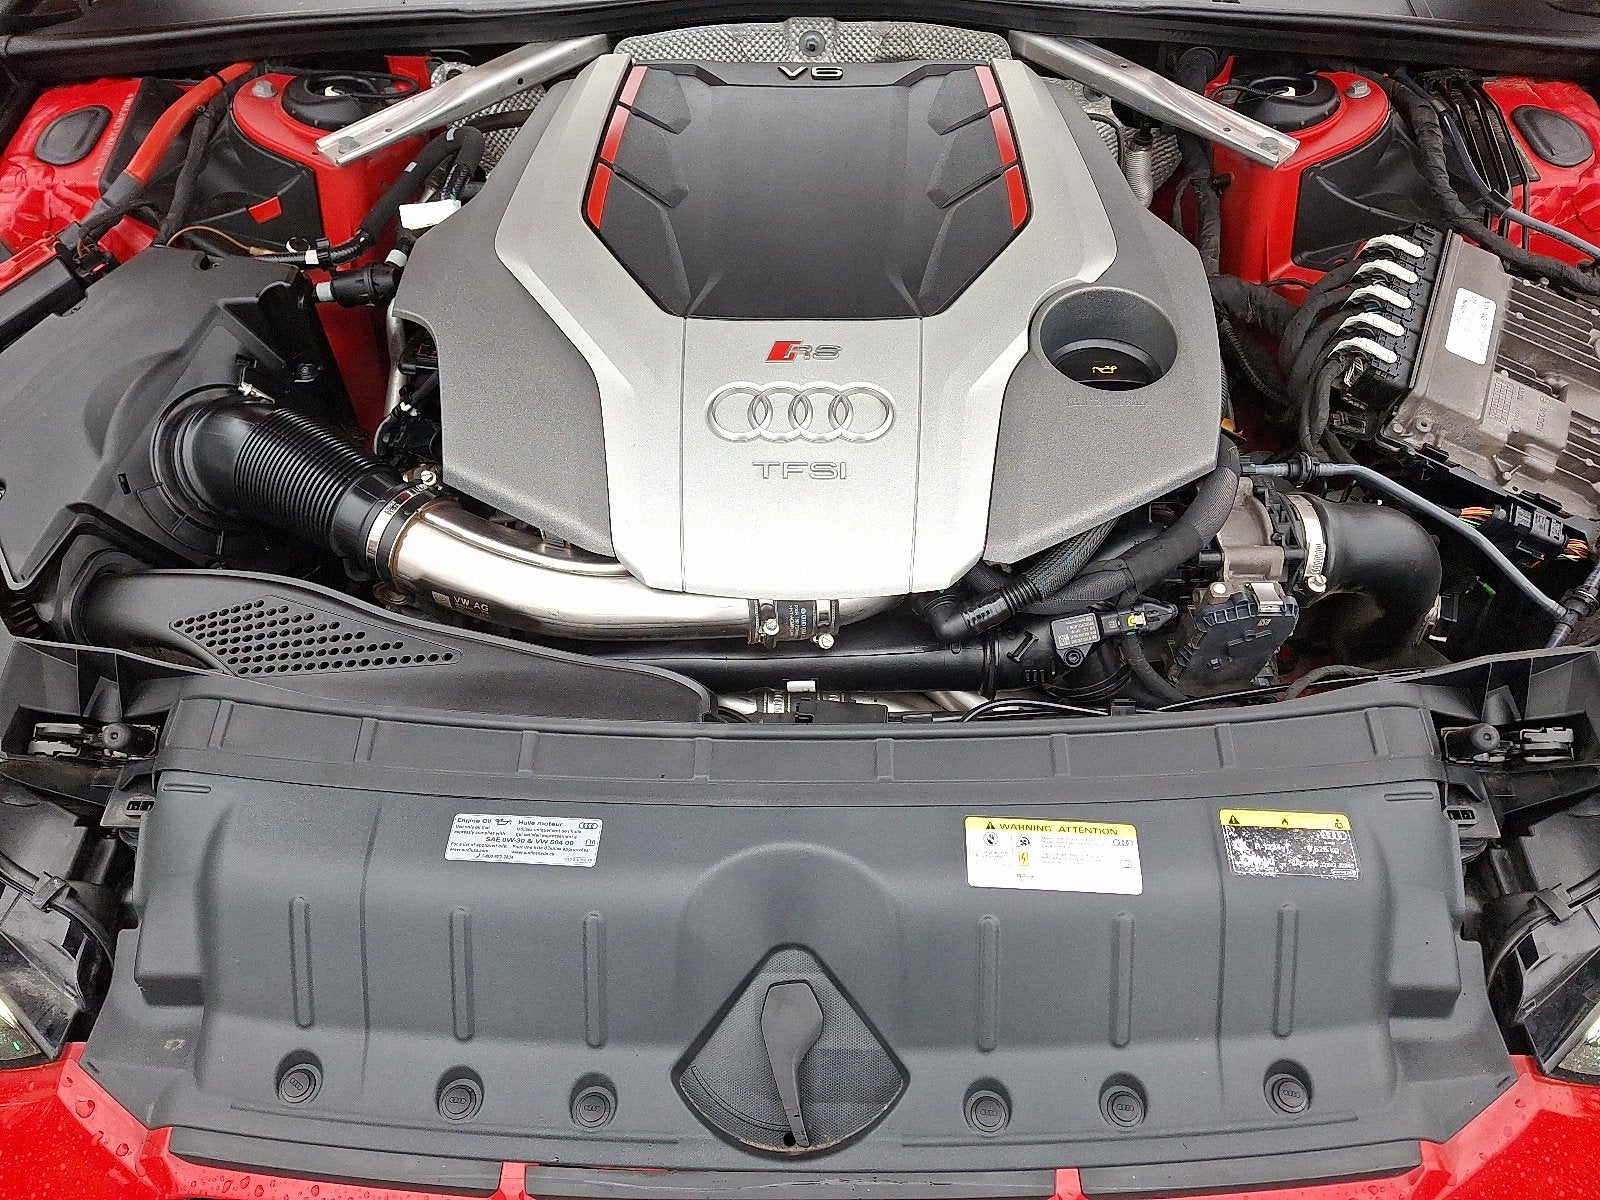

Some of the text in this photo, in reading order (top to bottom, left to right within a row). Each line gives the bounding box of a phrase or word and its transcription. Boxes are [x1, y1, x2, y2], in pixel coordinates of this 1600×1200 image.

[777, 66, 843, 80] V6
[776, 342, 842, 361] RS
[752, 461, 847, 480] TFSI
[453, 595, 470, 606] VW
[473, 601, 489, 612] AG
[999, 823, 1118, 835] WARNING ATTENTION
